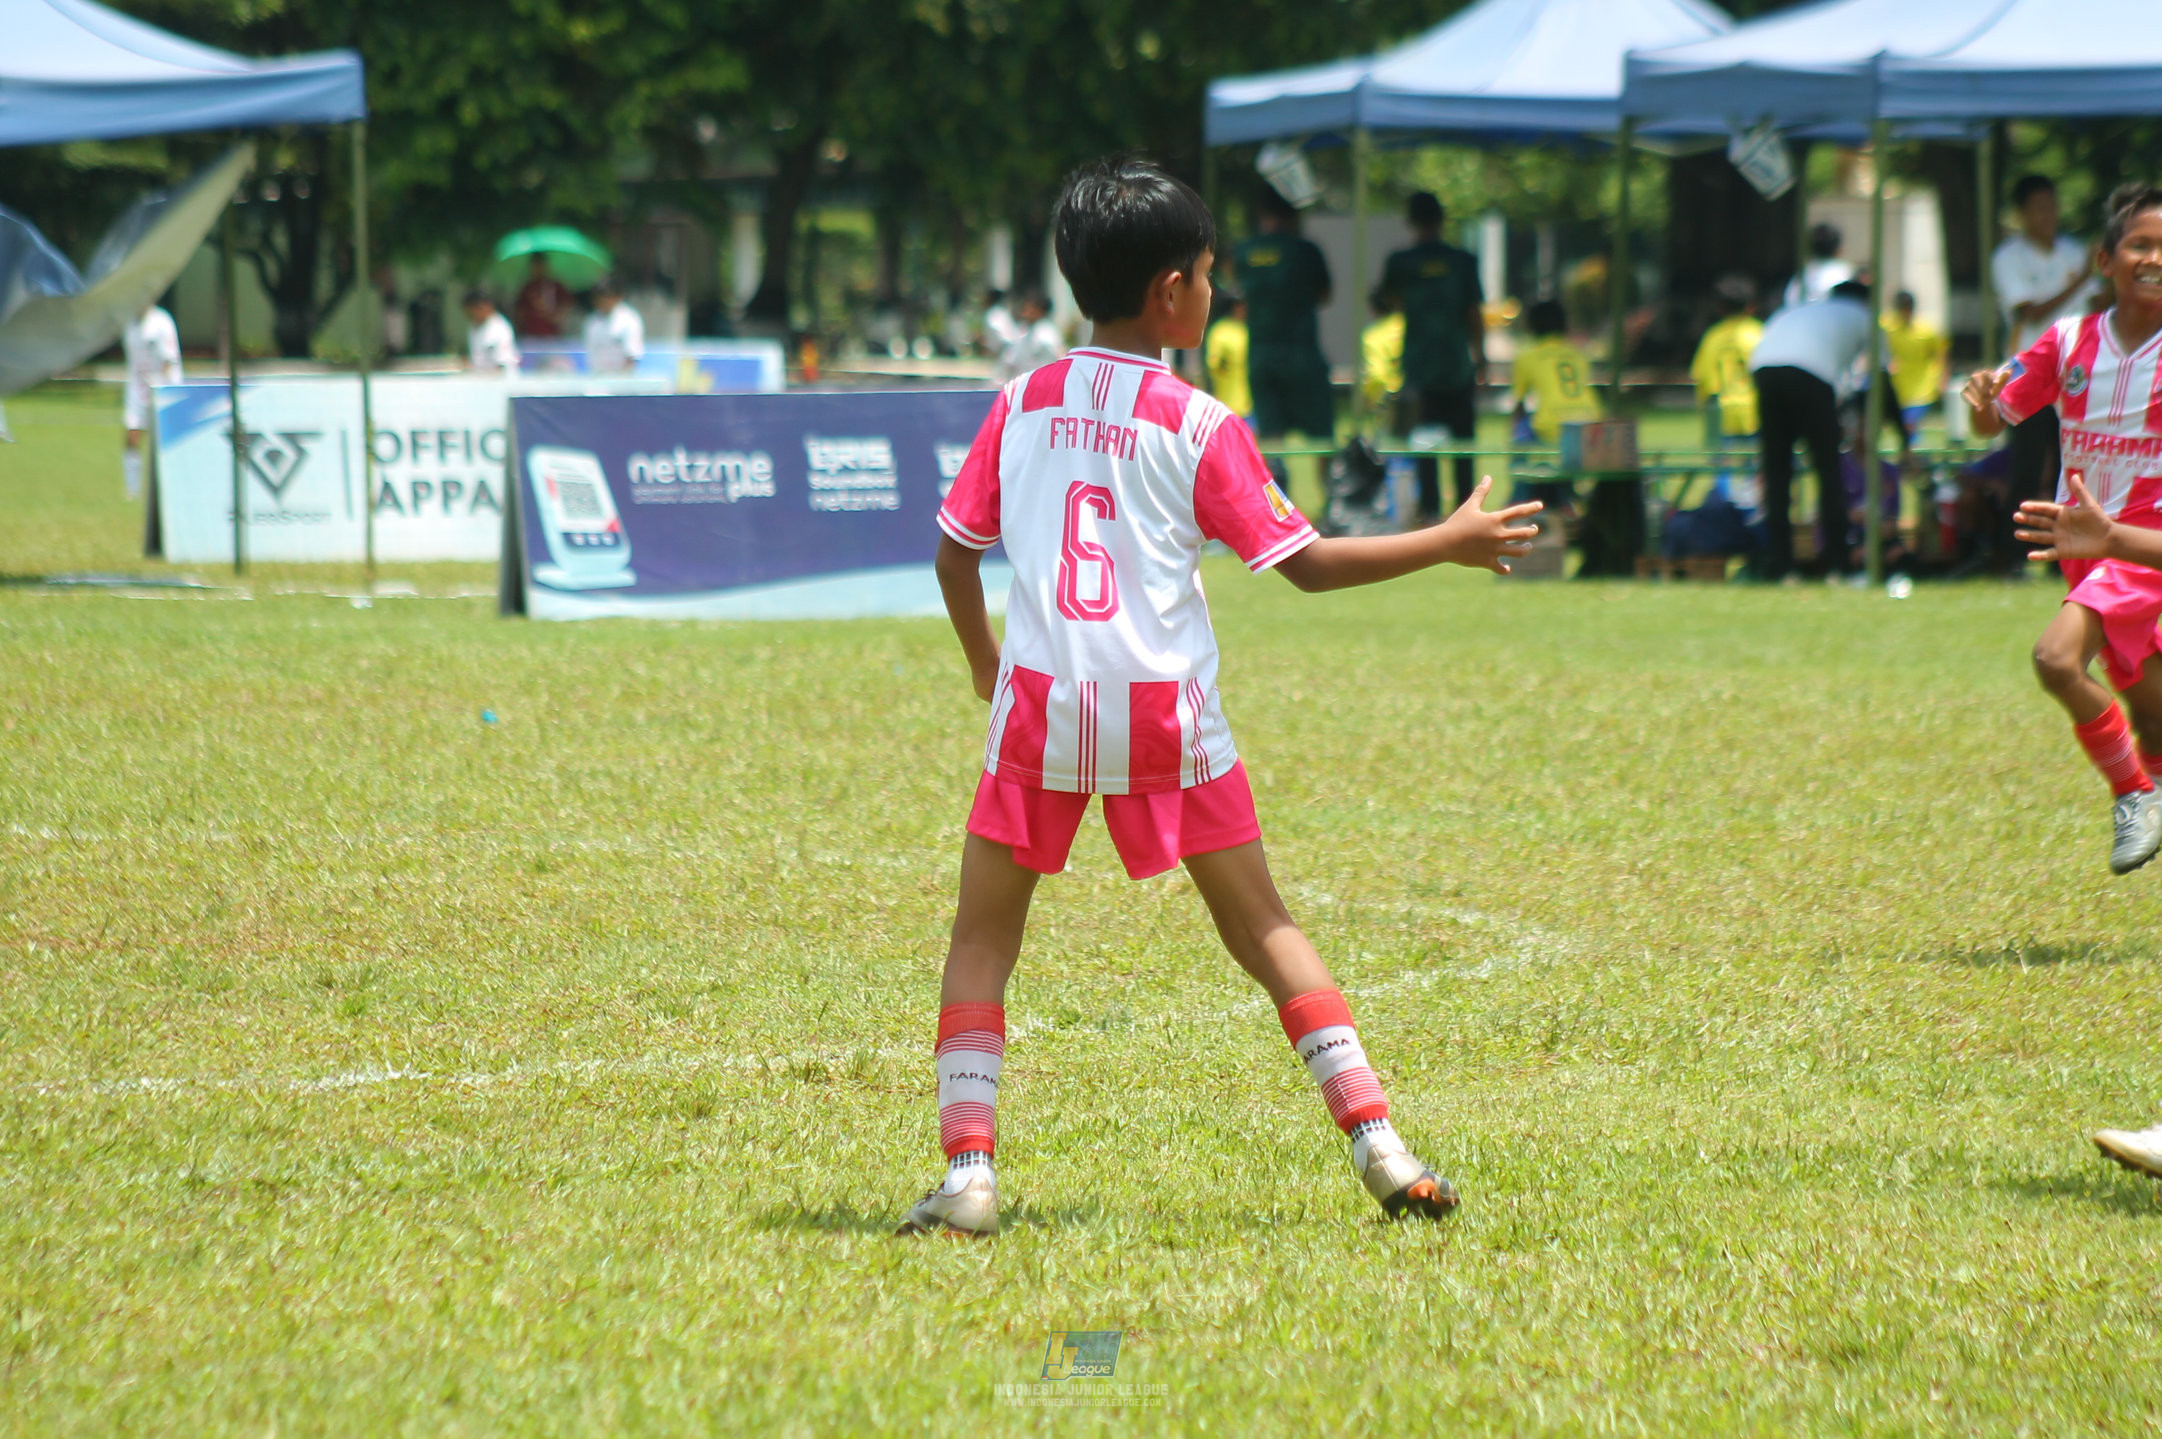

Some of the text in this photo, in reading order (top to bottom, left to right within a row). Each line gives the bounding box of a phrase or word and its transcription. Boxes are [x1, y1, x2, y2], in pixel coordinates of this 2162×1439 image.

[1050, 417, 1138, 461] FATHAN
[627, 444, 774, 484] netzme
[373, 479, 507, 519] APPA
[727, 480, 777, 503] plus
[1056, 480, 1120, 622] 6
